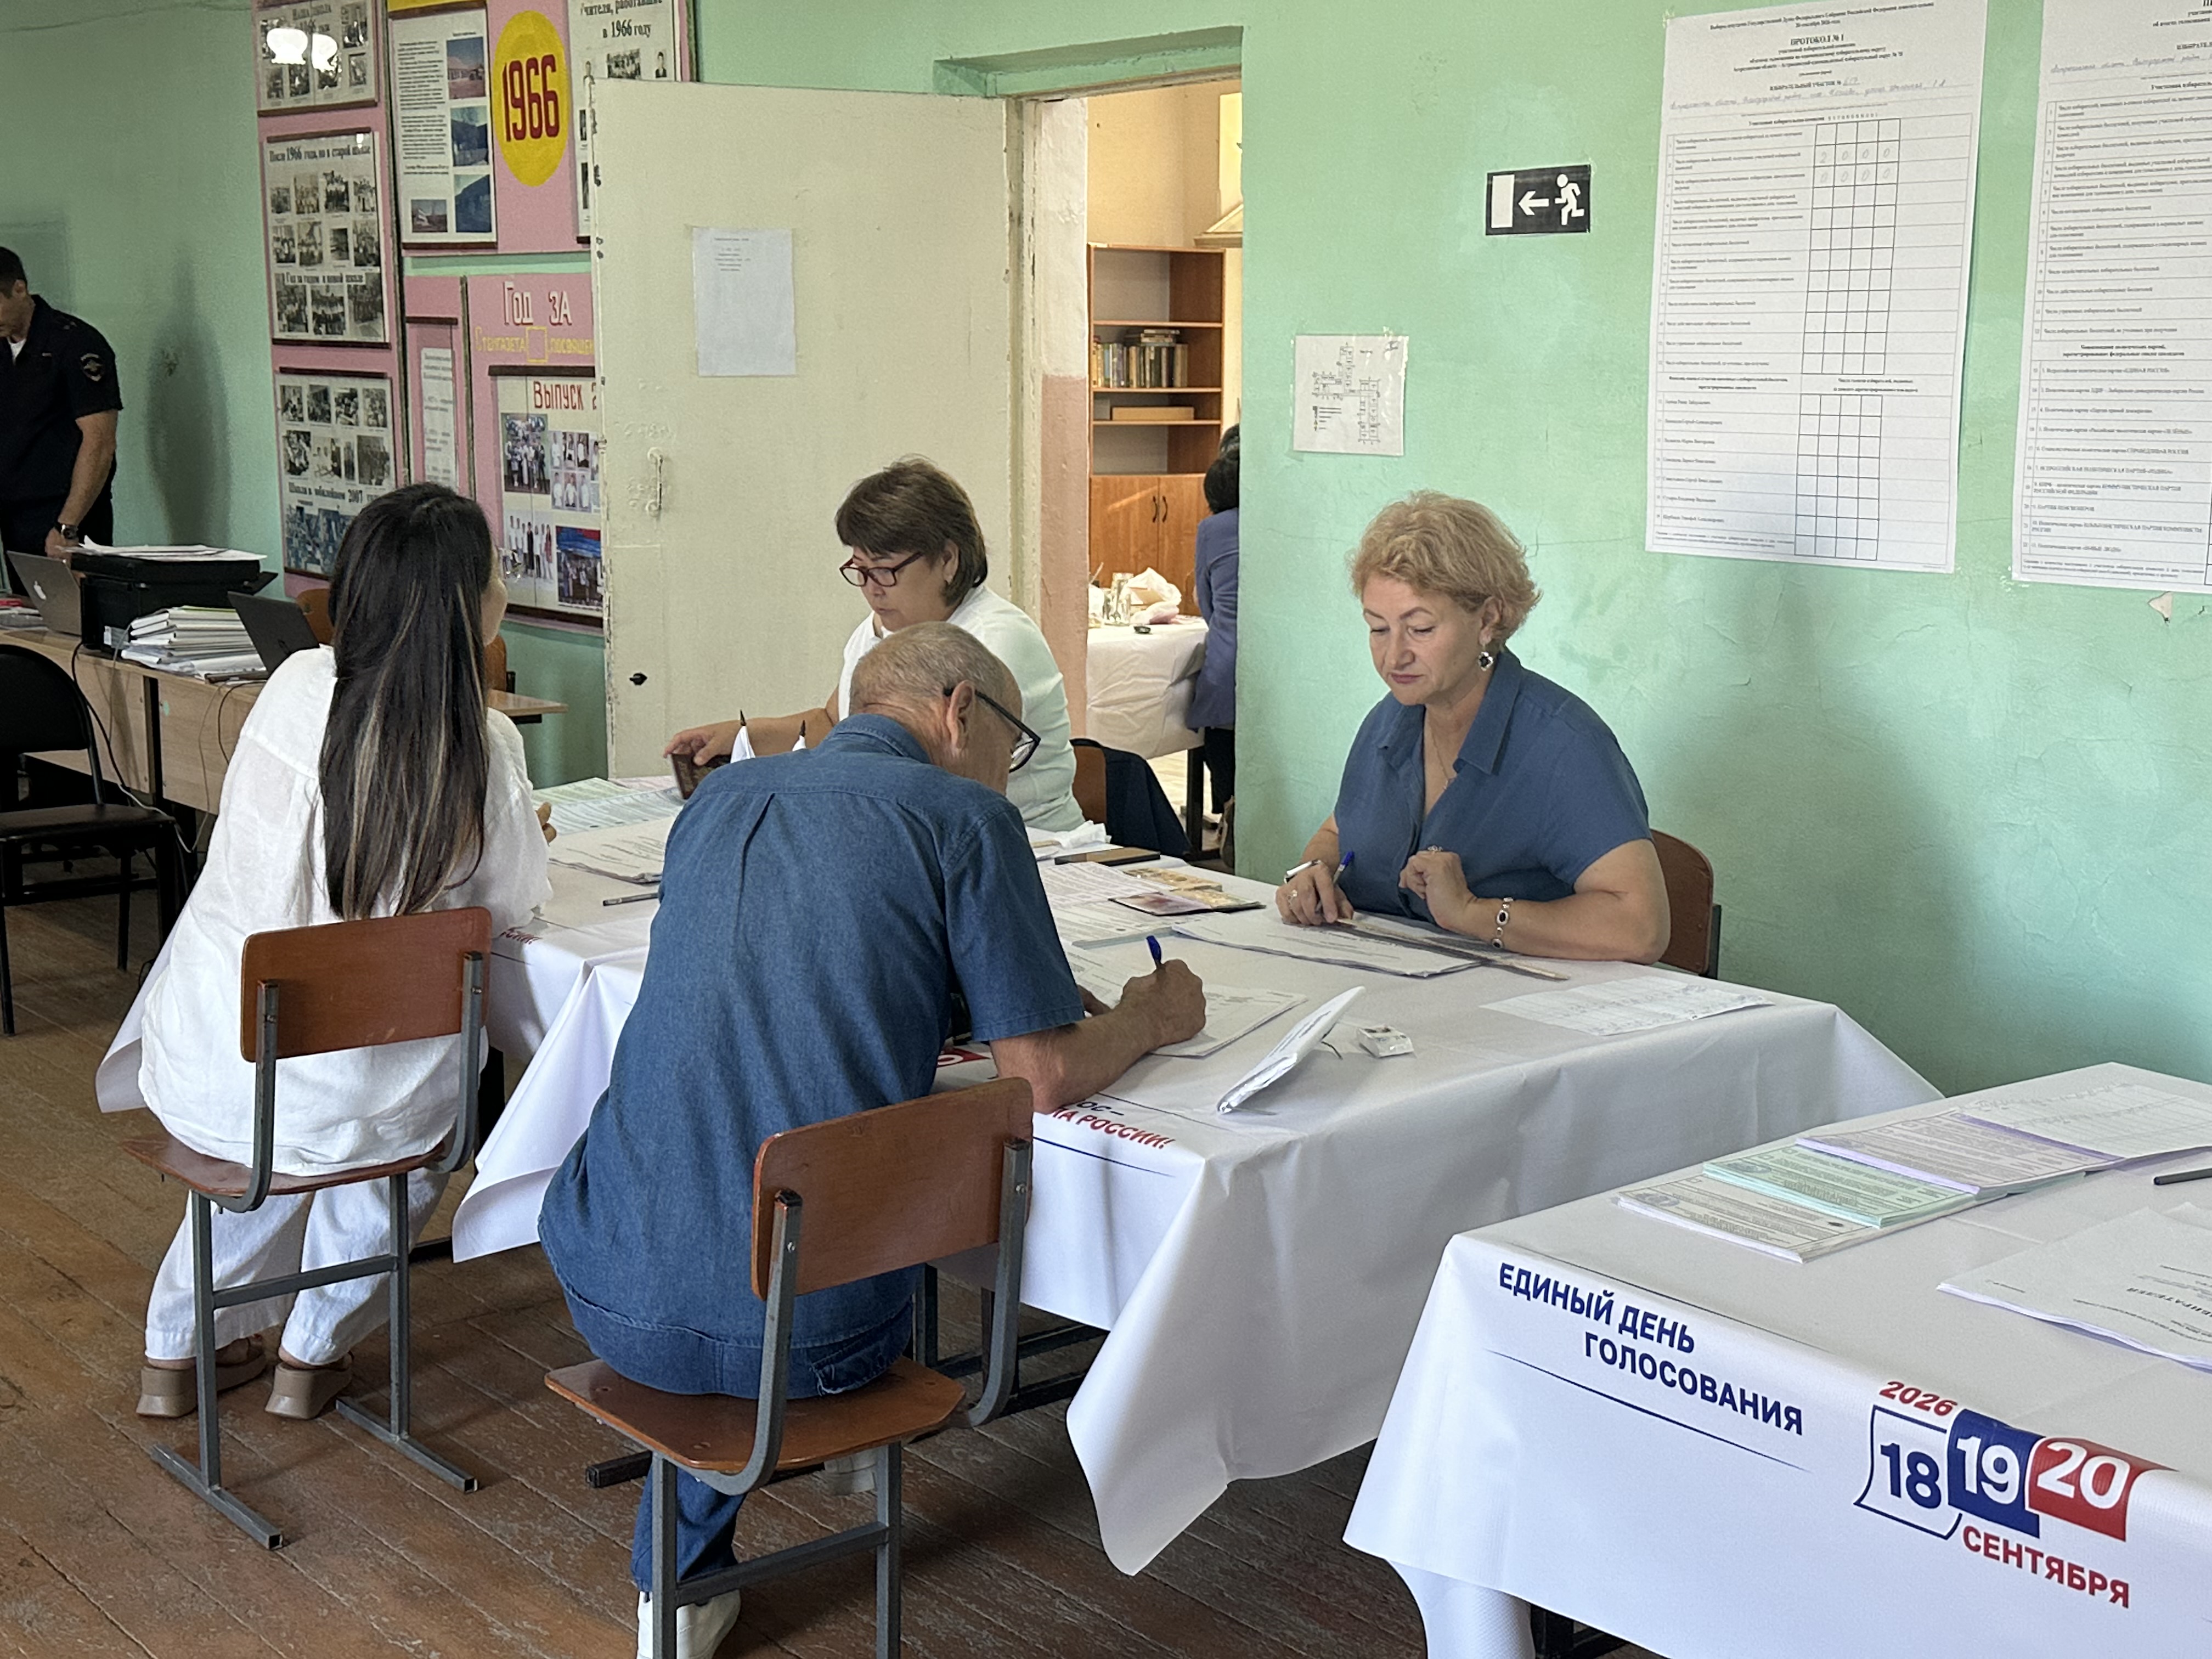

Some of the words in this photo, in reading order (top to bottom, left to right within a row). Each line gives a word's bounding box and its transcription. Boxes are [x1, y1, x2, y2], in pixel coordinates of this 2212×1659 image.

[602, 28, 608, 38] в
[611, 19, 633, 37] 1966
[634, 24, 651, 37] году
[501, 55, 560, 142] 1966
[286, 146, 302, 161] 1966
[1819, 151, 1827, 163] 2
[1842, 150, 1849, 161] 0
[1862, 149, 1870, 159] 0
[1883, 148, 1891, 158] 0
[1840, 171, 1849, 182] 0
[1861, 169, 1870, 181] 0
[1882, 167, 1891, 179] 0
[1075, 1115, 1177, 1150] РОССИИ!
[1499, 1262, 1614, 1325] ЕДИНЫЙ
[1618, 1305, 1695, 1353] ДЕНЬ
[1585, 1331, 1803, 1436] ГОЛОСОВАНИЯ
[1879, 1381, 1958, 1417] 2026
[1880, 1442, 1942, 1509] 18
[1956, 1435, 2021, 1505] 19
[2035, 1441, 2131, 1510] 20
[1962, 1525, 2130, 1609] СЕНТЯБРЯ
